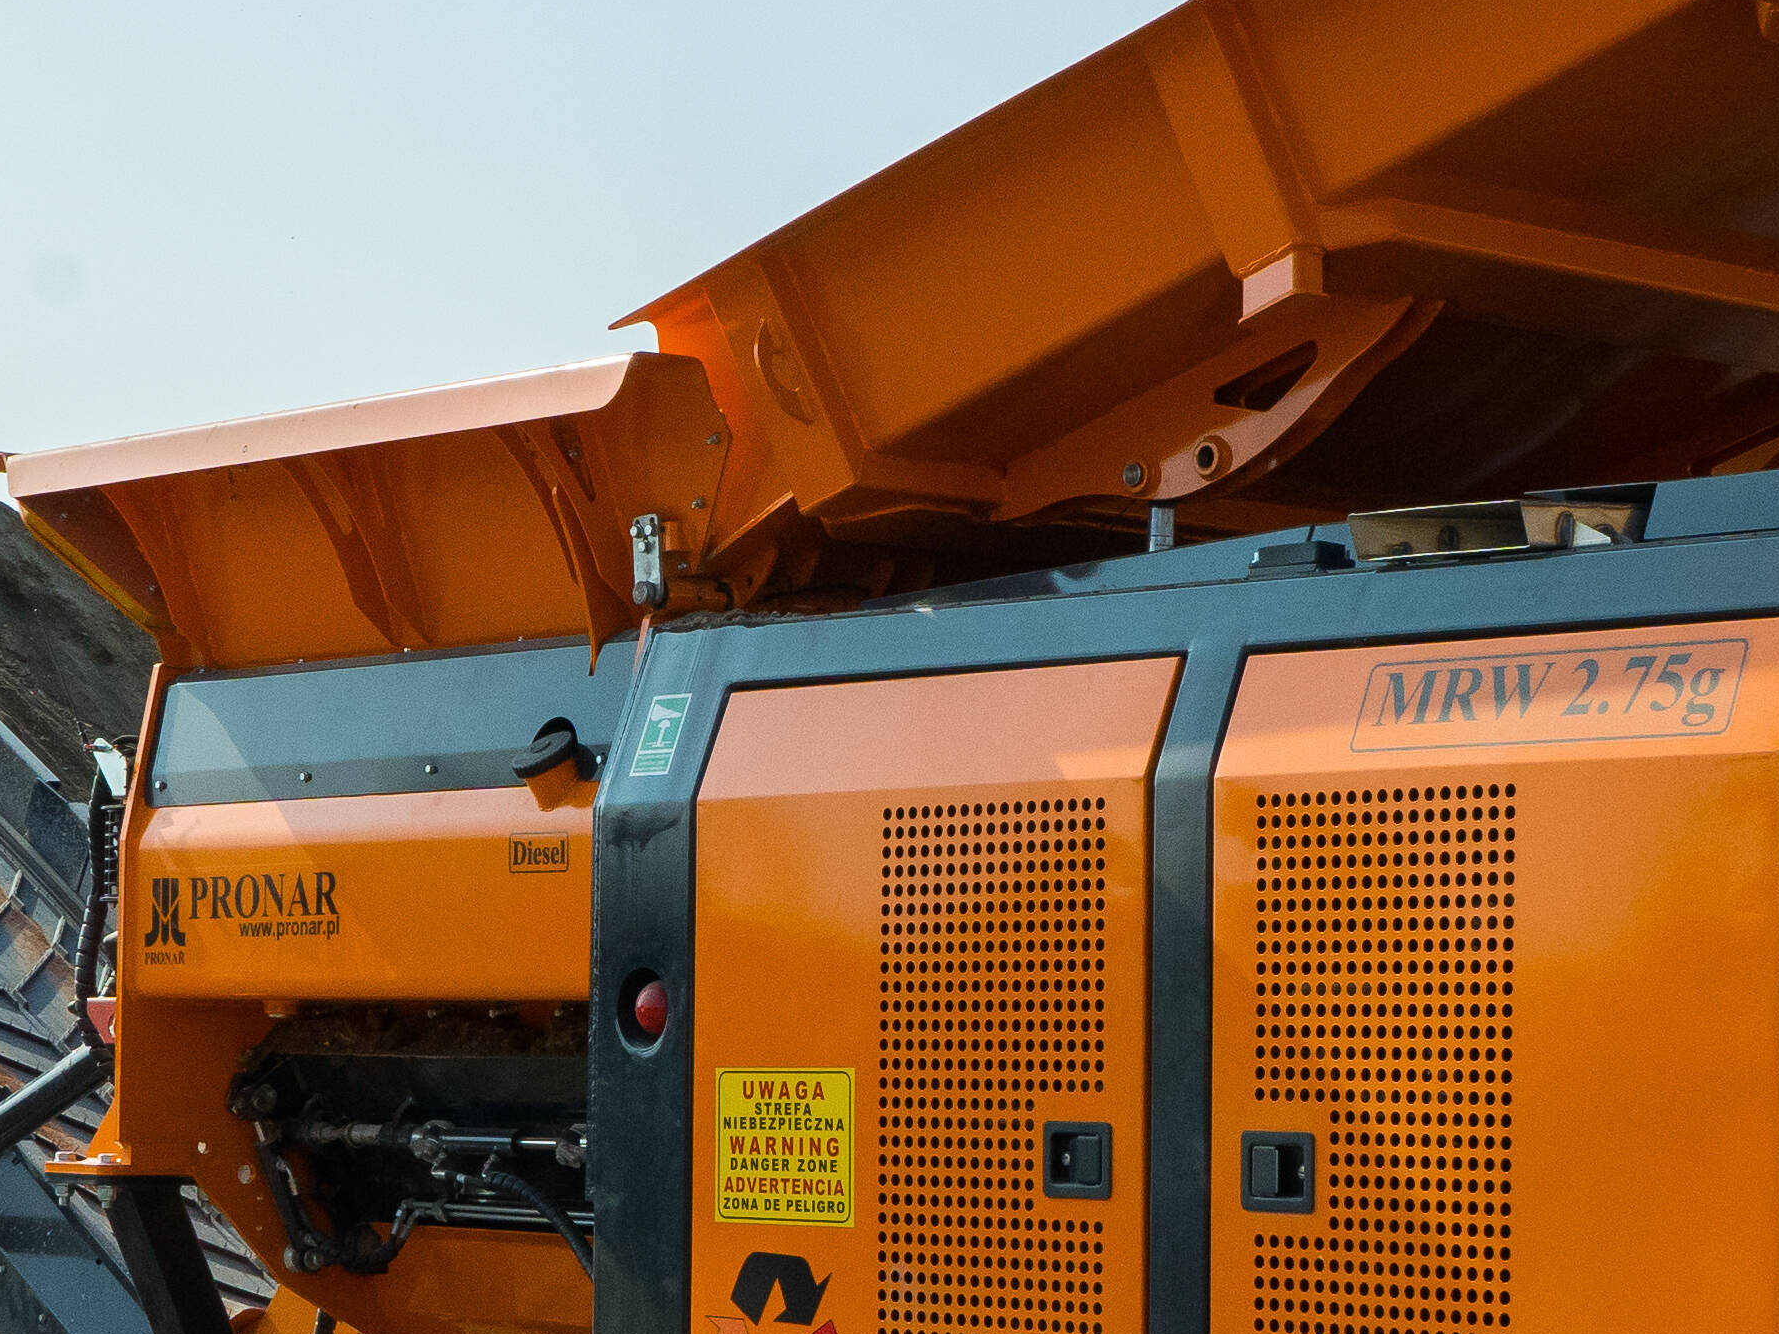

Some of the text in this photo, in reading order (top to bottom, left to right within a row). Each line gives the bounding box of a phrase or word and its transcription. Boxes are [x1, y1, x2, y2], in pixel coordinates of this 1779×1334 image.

[1371, 652, 1726, 728] MRW 2.75g
[513, 840, 566, 866] Diesel
[188, 871, 340, 919] PRONAR
[239, 915, 340, 941] www.pronar.pl
[144, 951, 186, 965] PRONAR
[742, 1080, 825, 1100] UWAGA
[754, 1102, 812, 1116] STREFA
[723, 1116, 845, 1132] NIEBEZPIECZNA
[729, 1135, 840, 1157] WARNING
[730, 1157, 838, 1173] DANGER ZONE
[724, 1176, 845, 1196] ADVERTENCIA
[723, 1197, 846, 1214] ZONA DE PELIGRO
